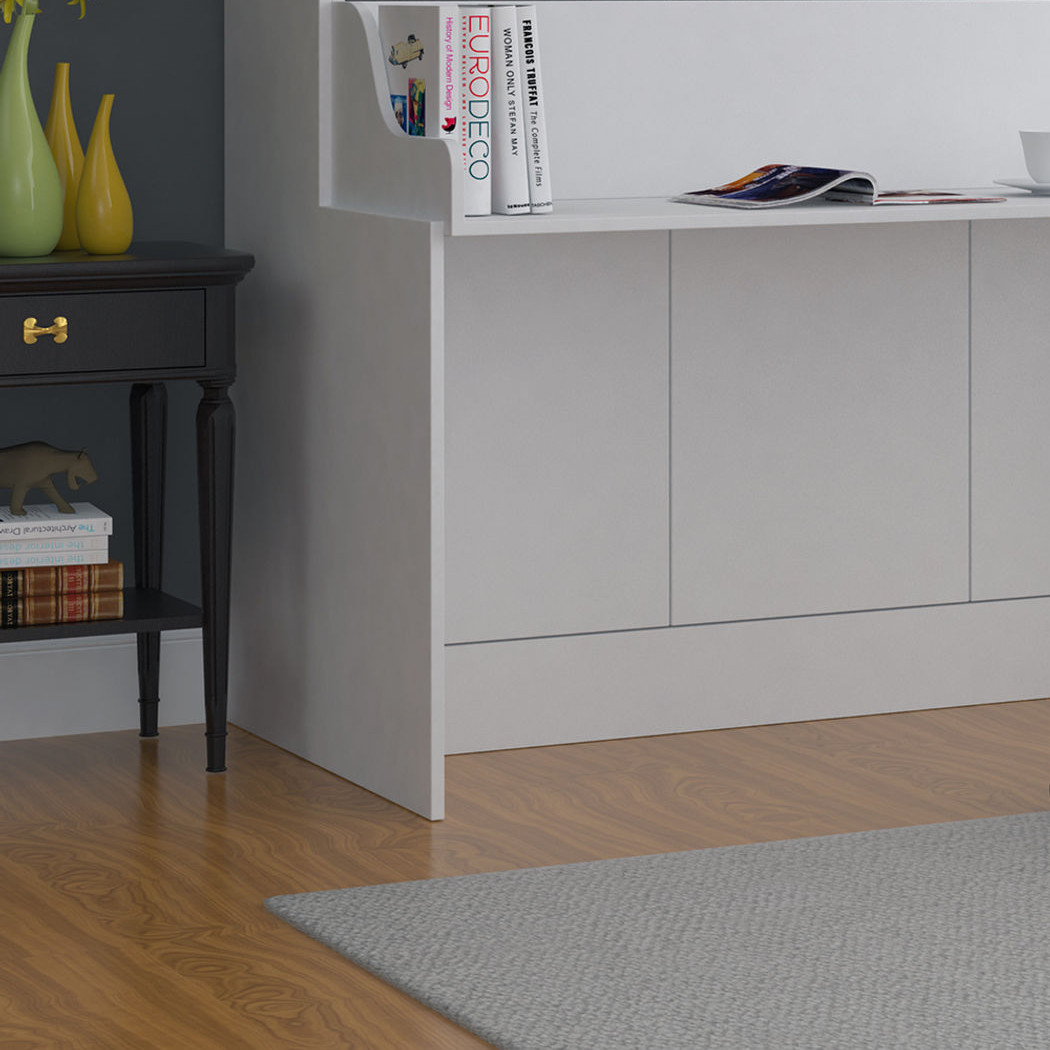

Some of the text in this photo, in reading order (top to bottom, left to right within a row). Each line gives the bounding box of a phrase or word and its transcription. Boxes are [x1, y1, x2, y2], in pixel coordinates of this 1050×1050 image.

[444, 16, 454, 110] History of Modern Design
[503, 27, 514, 67] WOMAN
[468, 15, 490, 180] EURODECO
[506, 70, 516, 97] ONLY
[522, 19, 543, 187] FRANCOIS TRUFFAT The Complete Films
[508, 99, 517, 134] STEFAN
[23, 524, 95, 535] The Architectural
